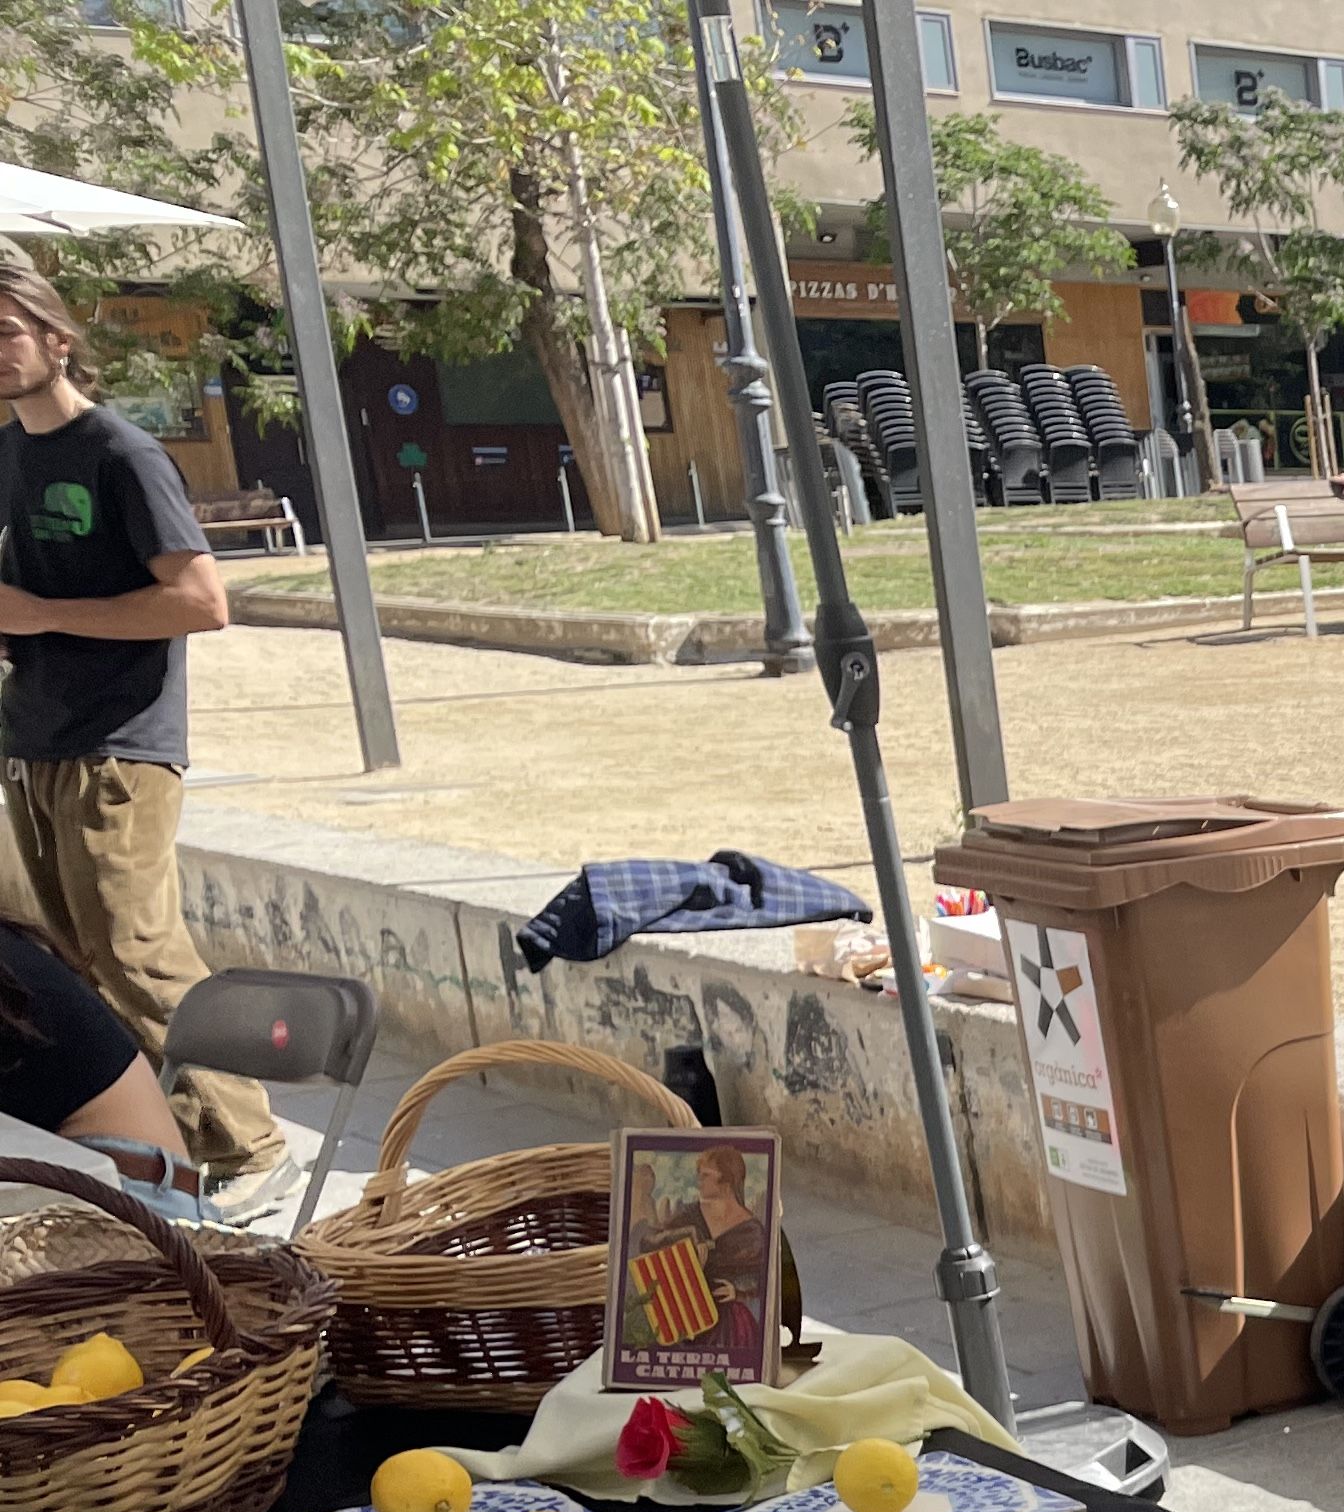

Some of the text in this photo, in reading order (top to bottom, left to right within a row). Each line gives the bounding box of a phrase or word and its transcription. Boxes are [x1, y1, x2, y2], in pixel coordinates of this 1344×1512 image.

[620, 1350, 730, 1366] LA TERRA
[635, 1364, 755, 1381] CATALNA
